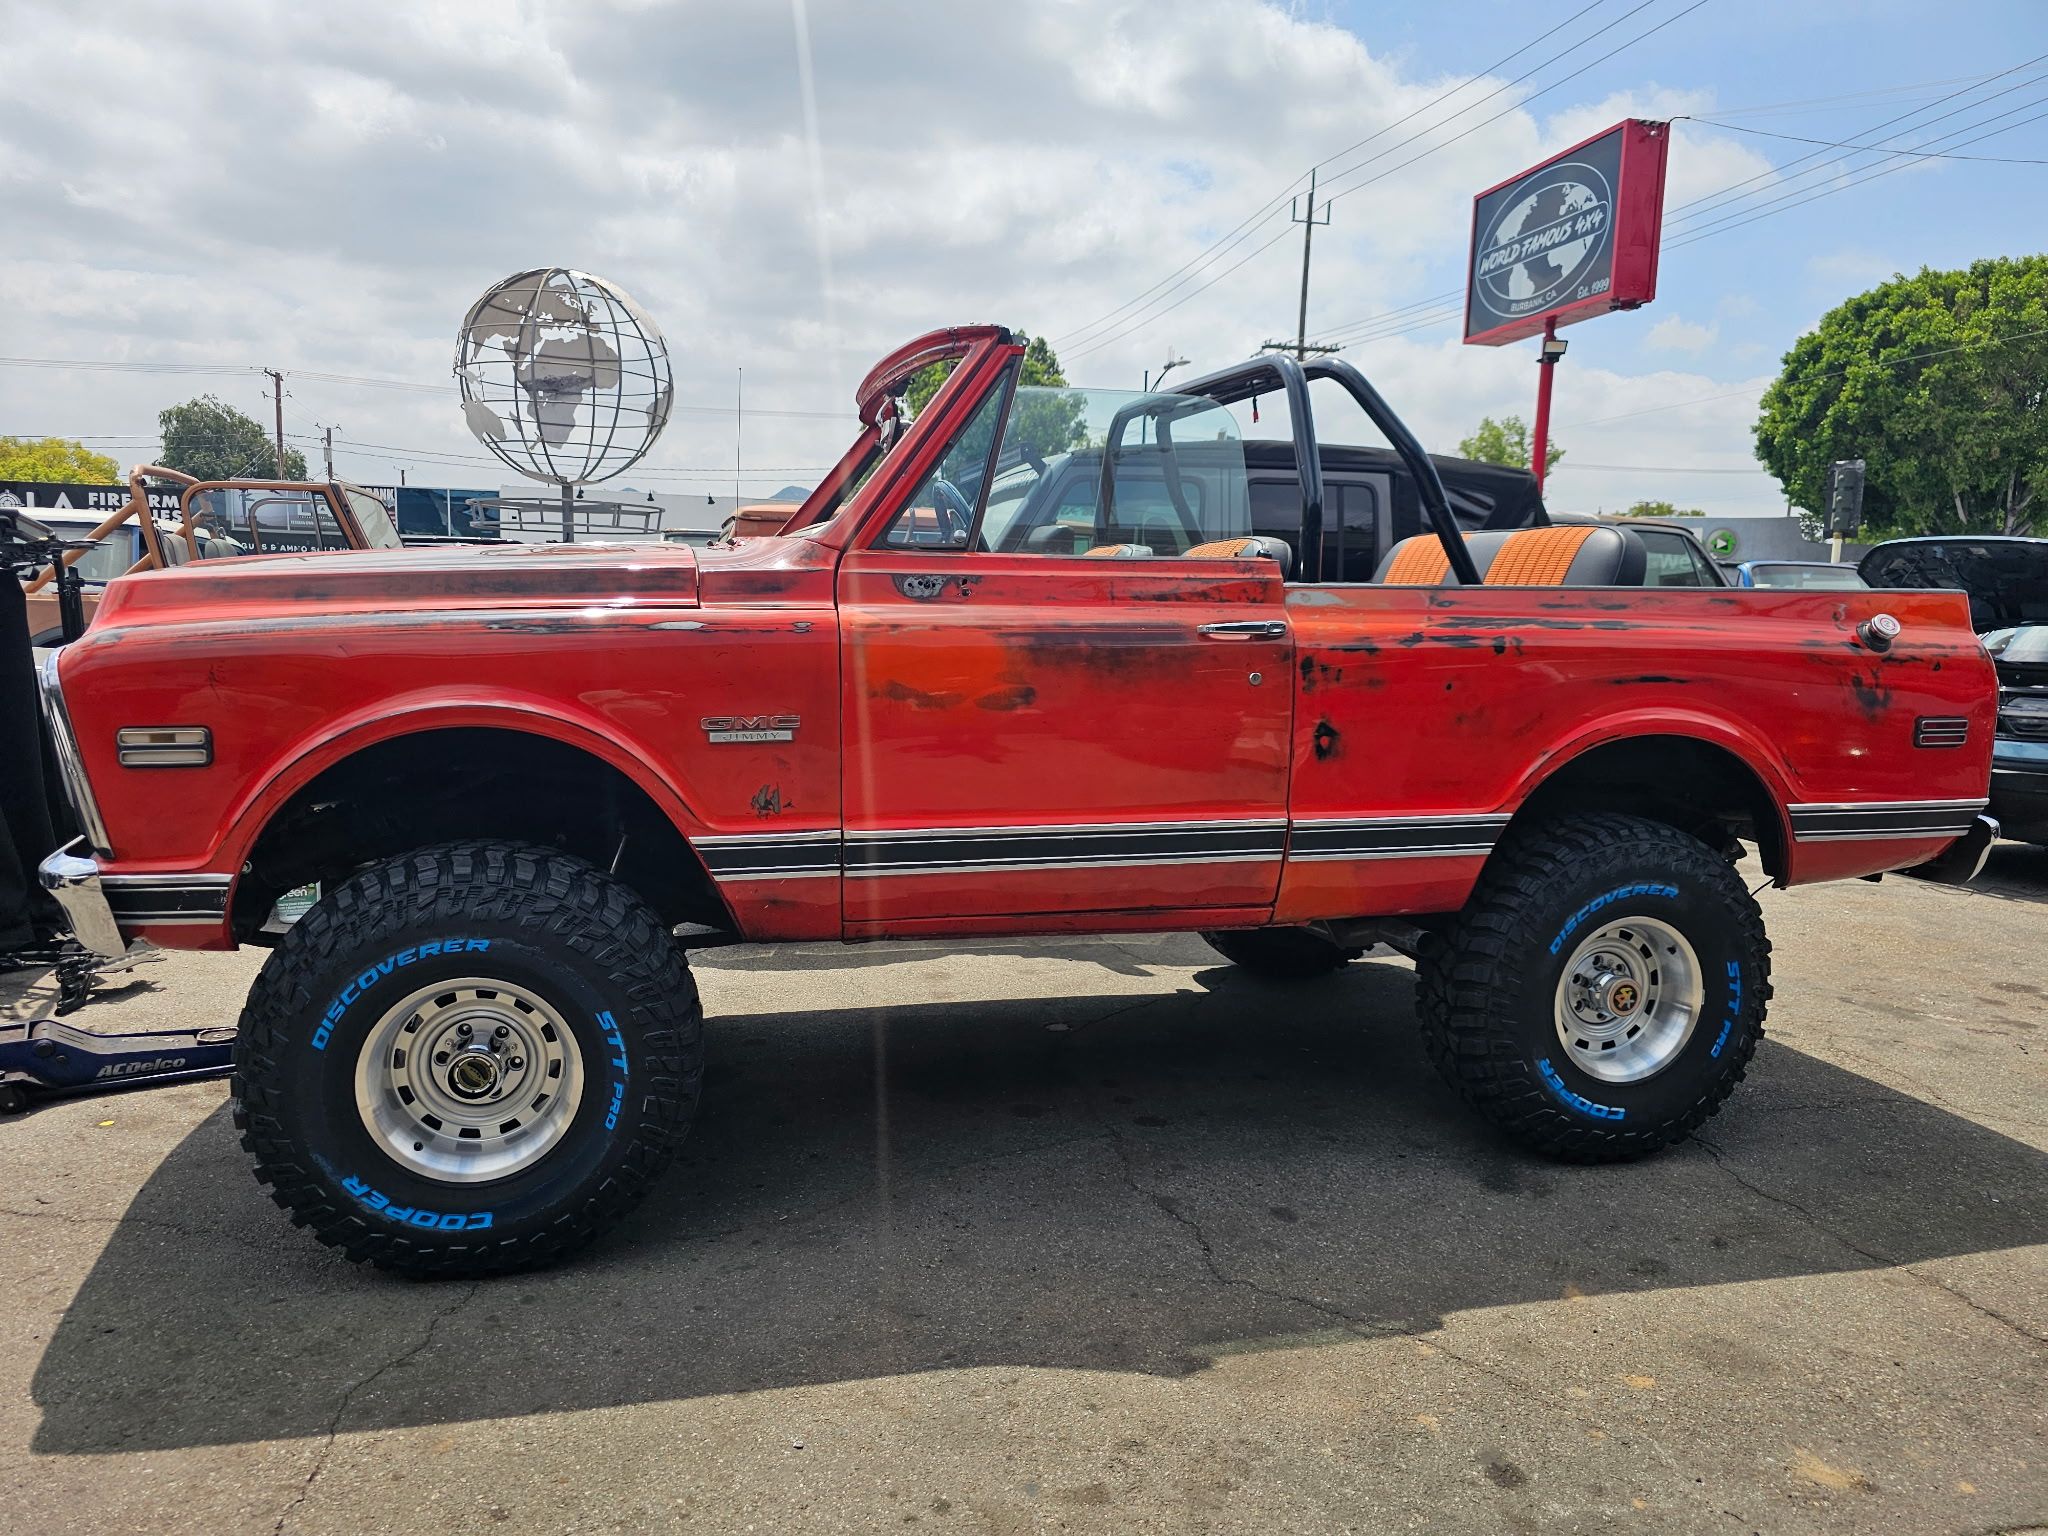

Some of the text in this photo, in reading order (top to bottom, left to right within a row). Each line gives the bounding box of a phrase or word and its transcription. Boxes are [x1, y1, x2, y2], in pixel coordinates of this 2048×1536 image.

[1480, 244, 1519, 275] WORLD
[1521, 221, 1572, 258] FAMOUS
[1546, 290, 1557, 301] CA
[1591, 278, 1610, 292] 1999
[88, 492, 180, 508] FIRERM
[242, 543, 268, 551] GUS
[700, 716, 800, 730] GMC
[723, 732, 780, 741] JIMMY
[1550, 883, 1679, 955] DISCOVERER
[311, 938, 491, 1050] DISCOVERER
[1710, 960, 1741, 1058] STT PRO
[96, 1057, 186, 1078] ACDelco
[594, 1010, 629, 1130] STT PRO
[1538, 1057, 1626, 1121] COOPER
[341, 1173, 495, 1231] COOPER
